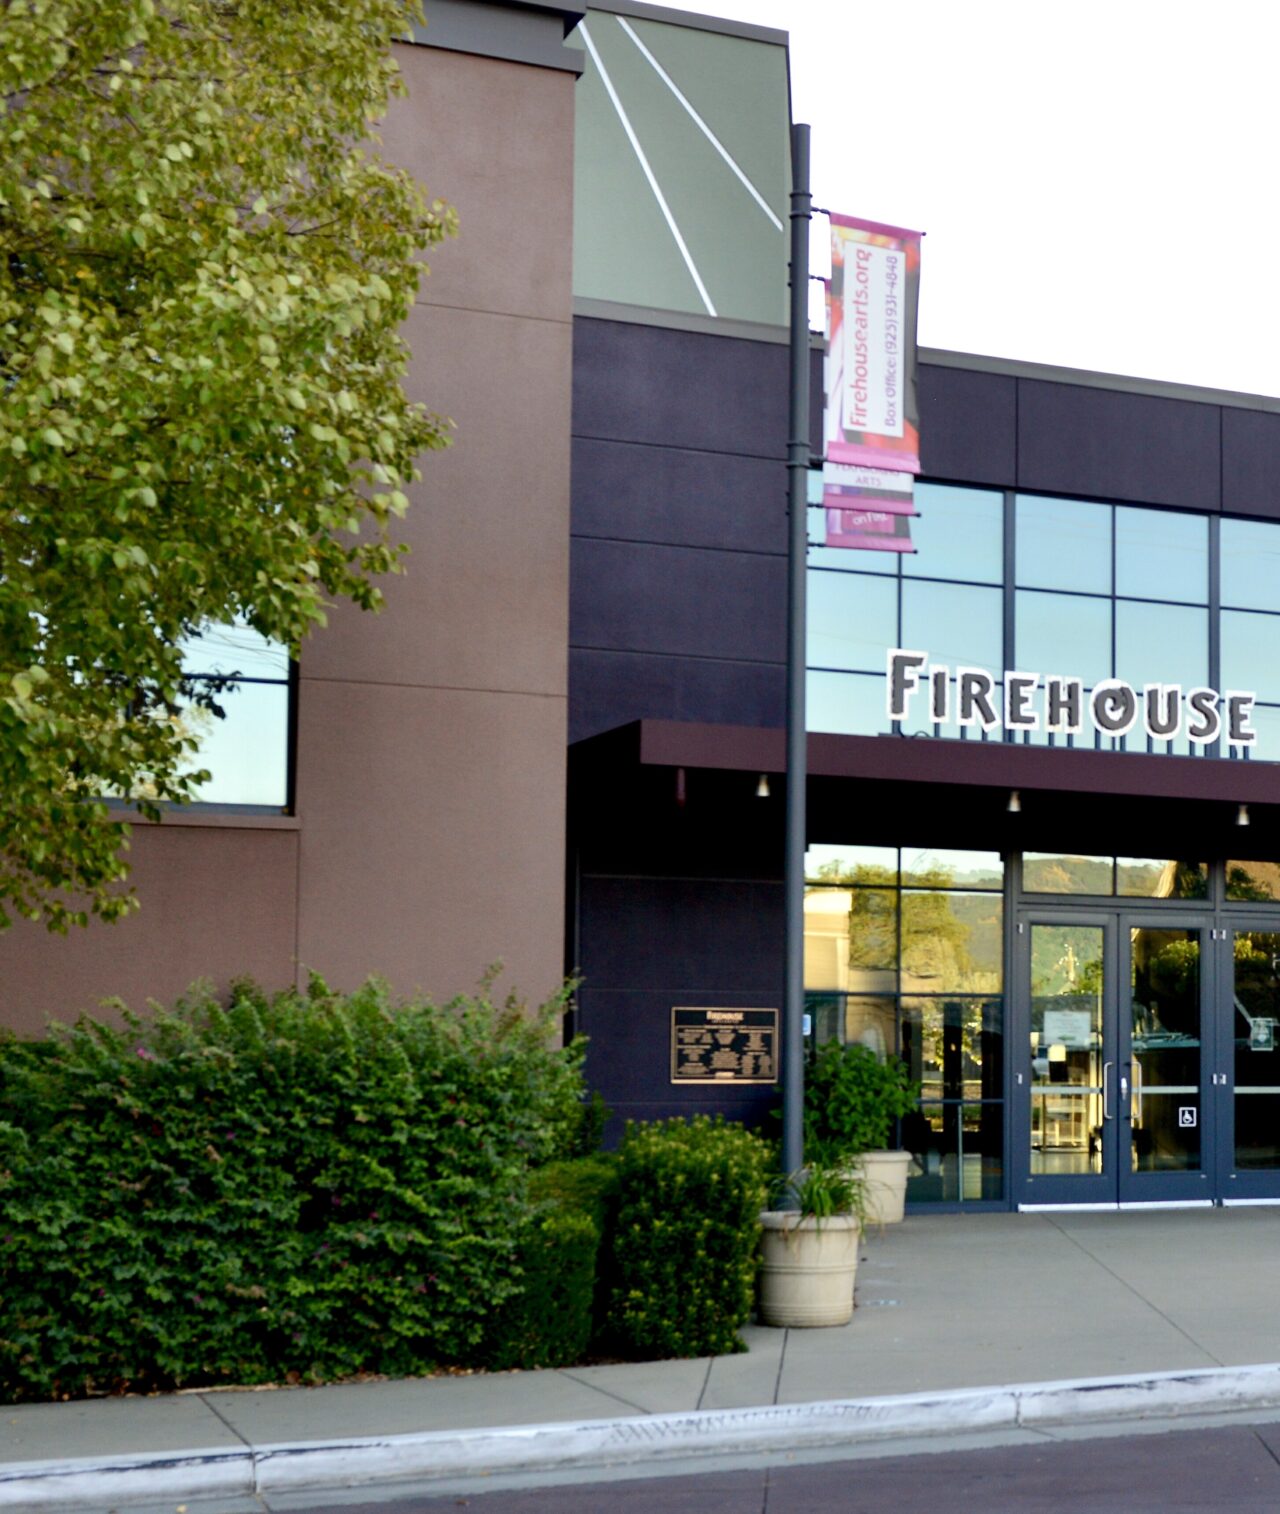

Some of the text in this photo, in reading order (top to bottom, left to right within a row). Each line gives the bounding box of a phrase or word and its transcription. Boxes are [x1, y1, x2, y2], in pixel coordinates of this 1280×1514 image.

[885, 255, 898, 317] 931-4848
[849, 248, 872, 427] Firehousearts.org
[884, 319, 899, 355] (925)
[884, 400, 897, 427] Box
[887, 649, 1256, 746] FIREHOUSE
